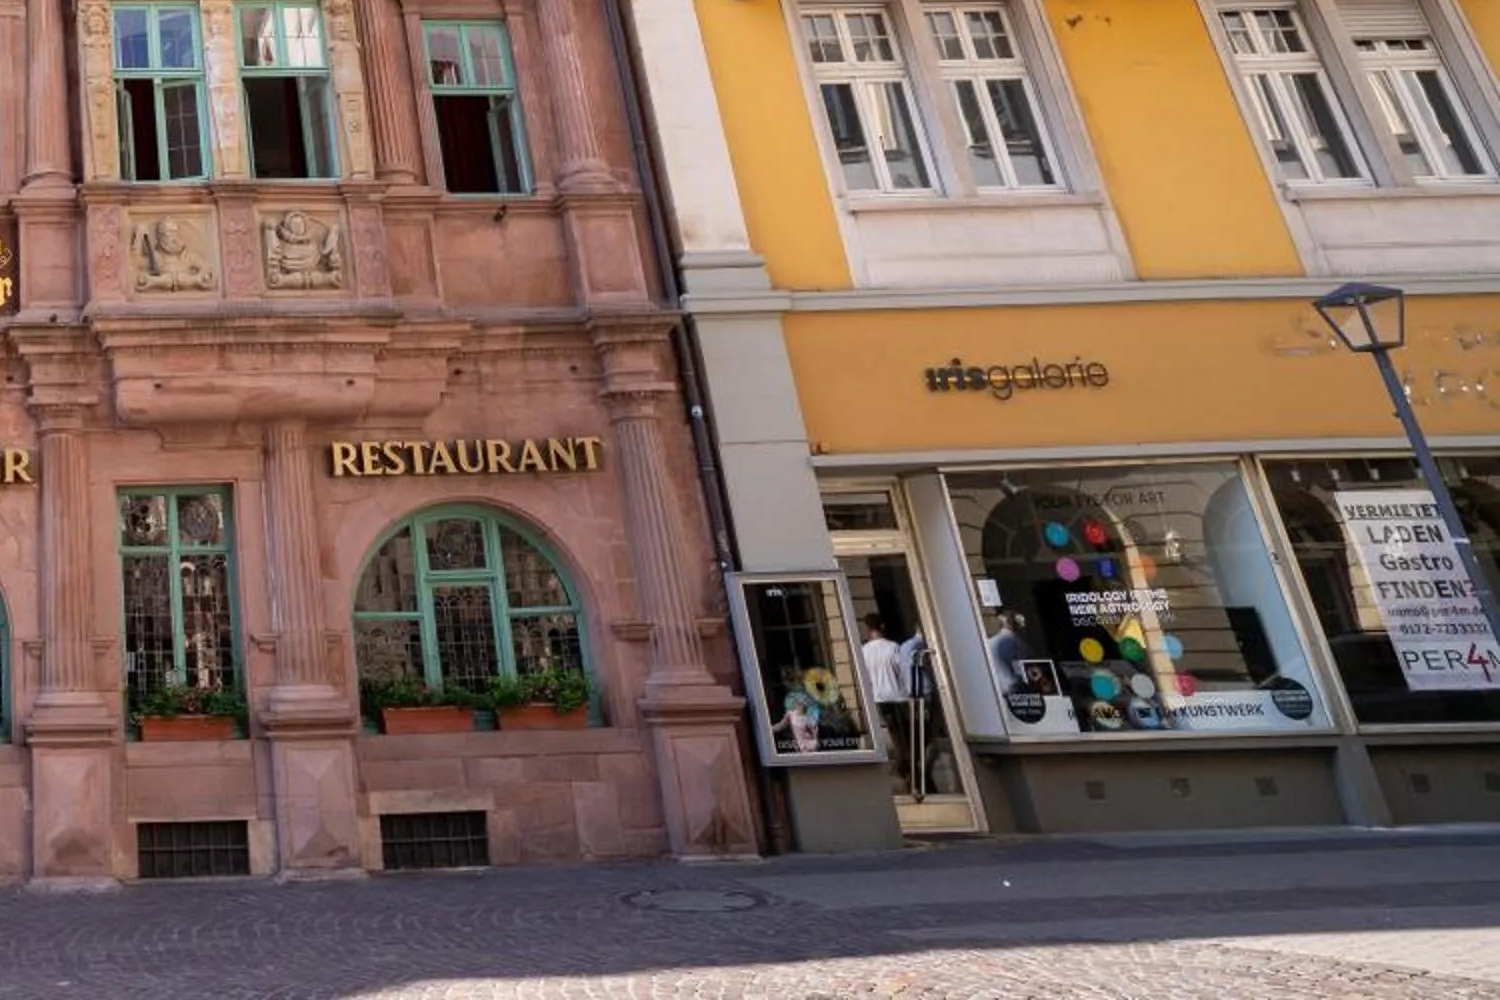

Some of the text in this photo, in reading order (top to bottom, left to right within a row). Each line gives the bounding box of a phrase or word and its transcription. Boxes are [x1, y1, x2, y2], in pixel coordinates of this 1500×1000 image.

[331, 436, 601, 476] RESTAURANT
[1139, 491, 1165, 505] ART
[1367, 525, 1444, 544] LADEN
[1379, 553, 1454, 571] Gastro
[1180, 702, 1265, 718] KUNSTWERK
